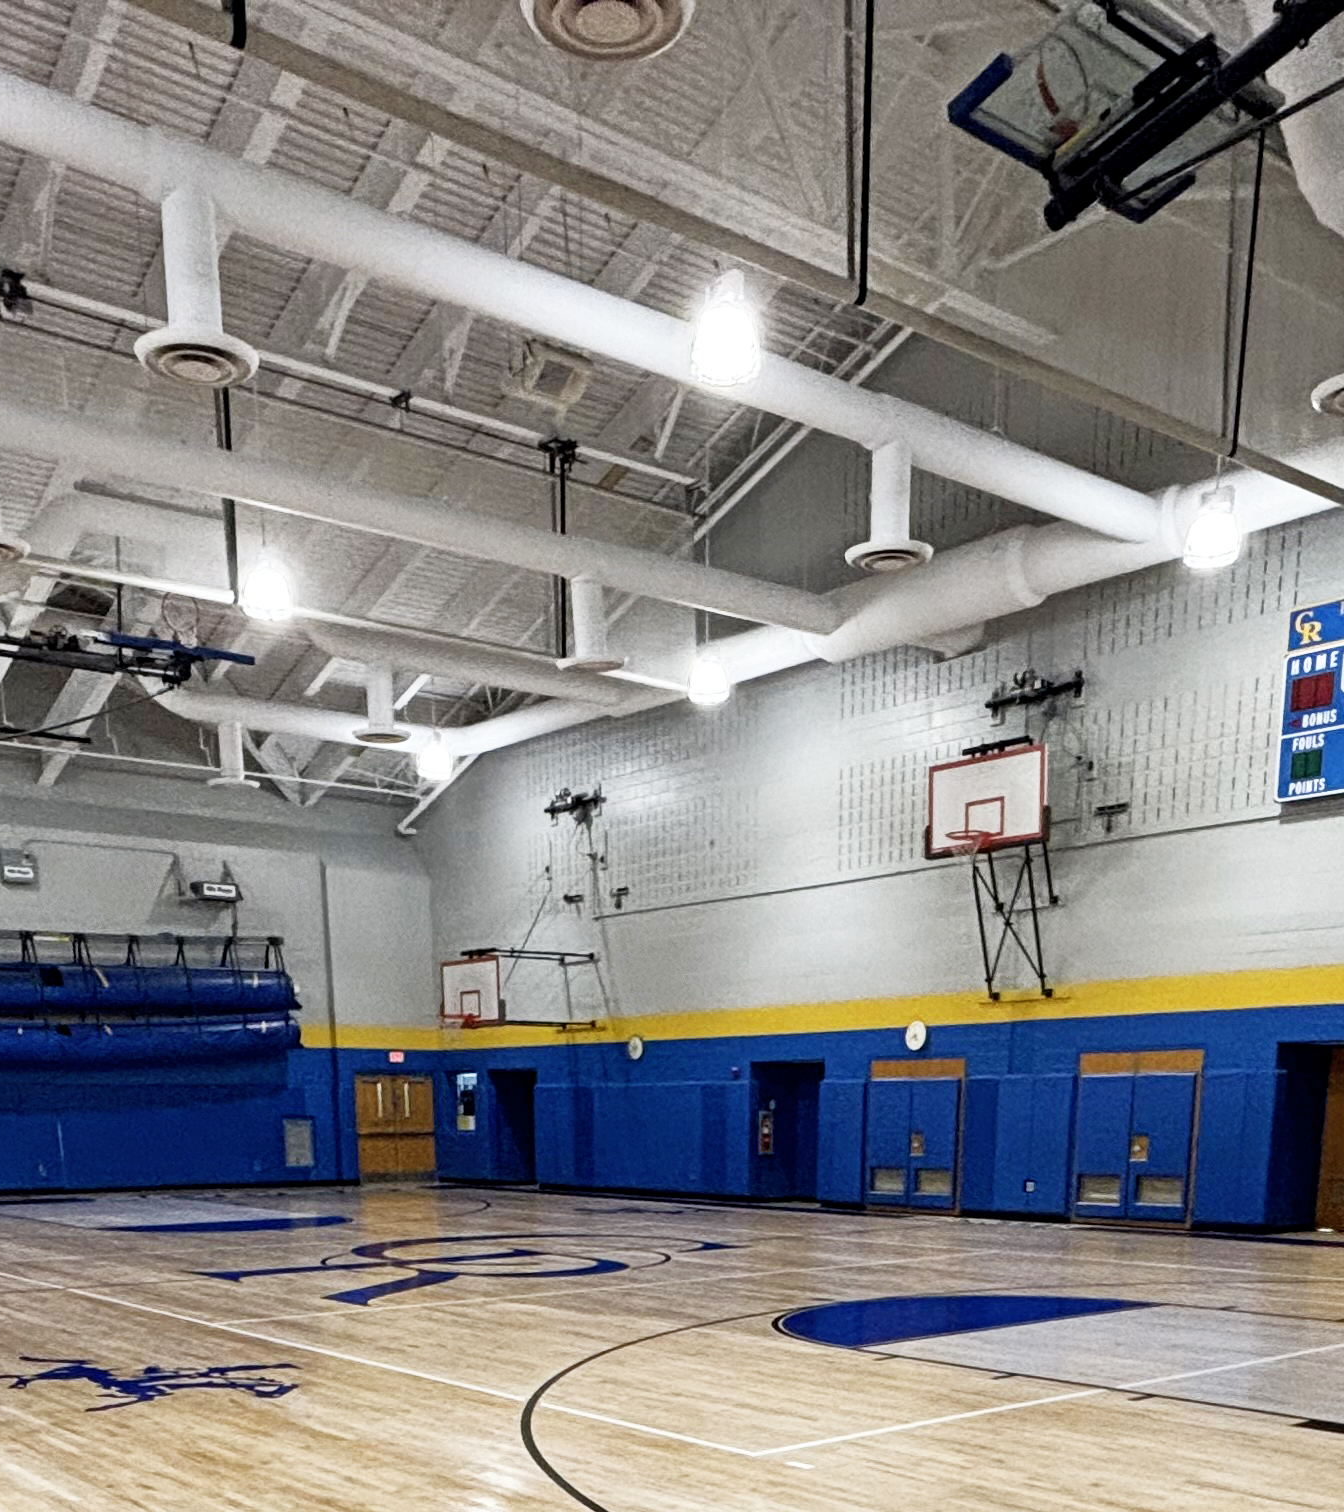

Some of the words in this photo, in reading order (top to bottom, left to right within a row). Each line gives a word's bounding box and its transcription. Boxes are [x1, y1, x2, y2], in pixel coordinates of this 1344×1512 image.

[1291, 651, 1339, 675] HOME
[1302, 709, 1337, 728] BONUS
[1292, 734, 1325, 752] FOULS
[1288, 778, 1325, 796] POINTS
